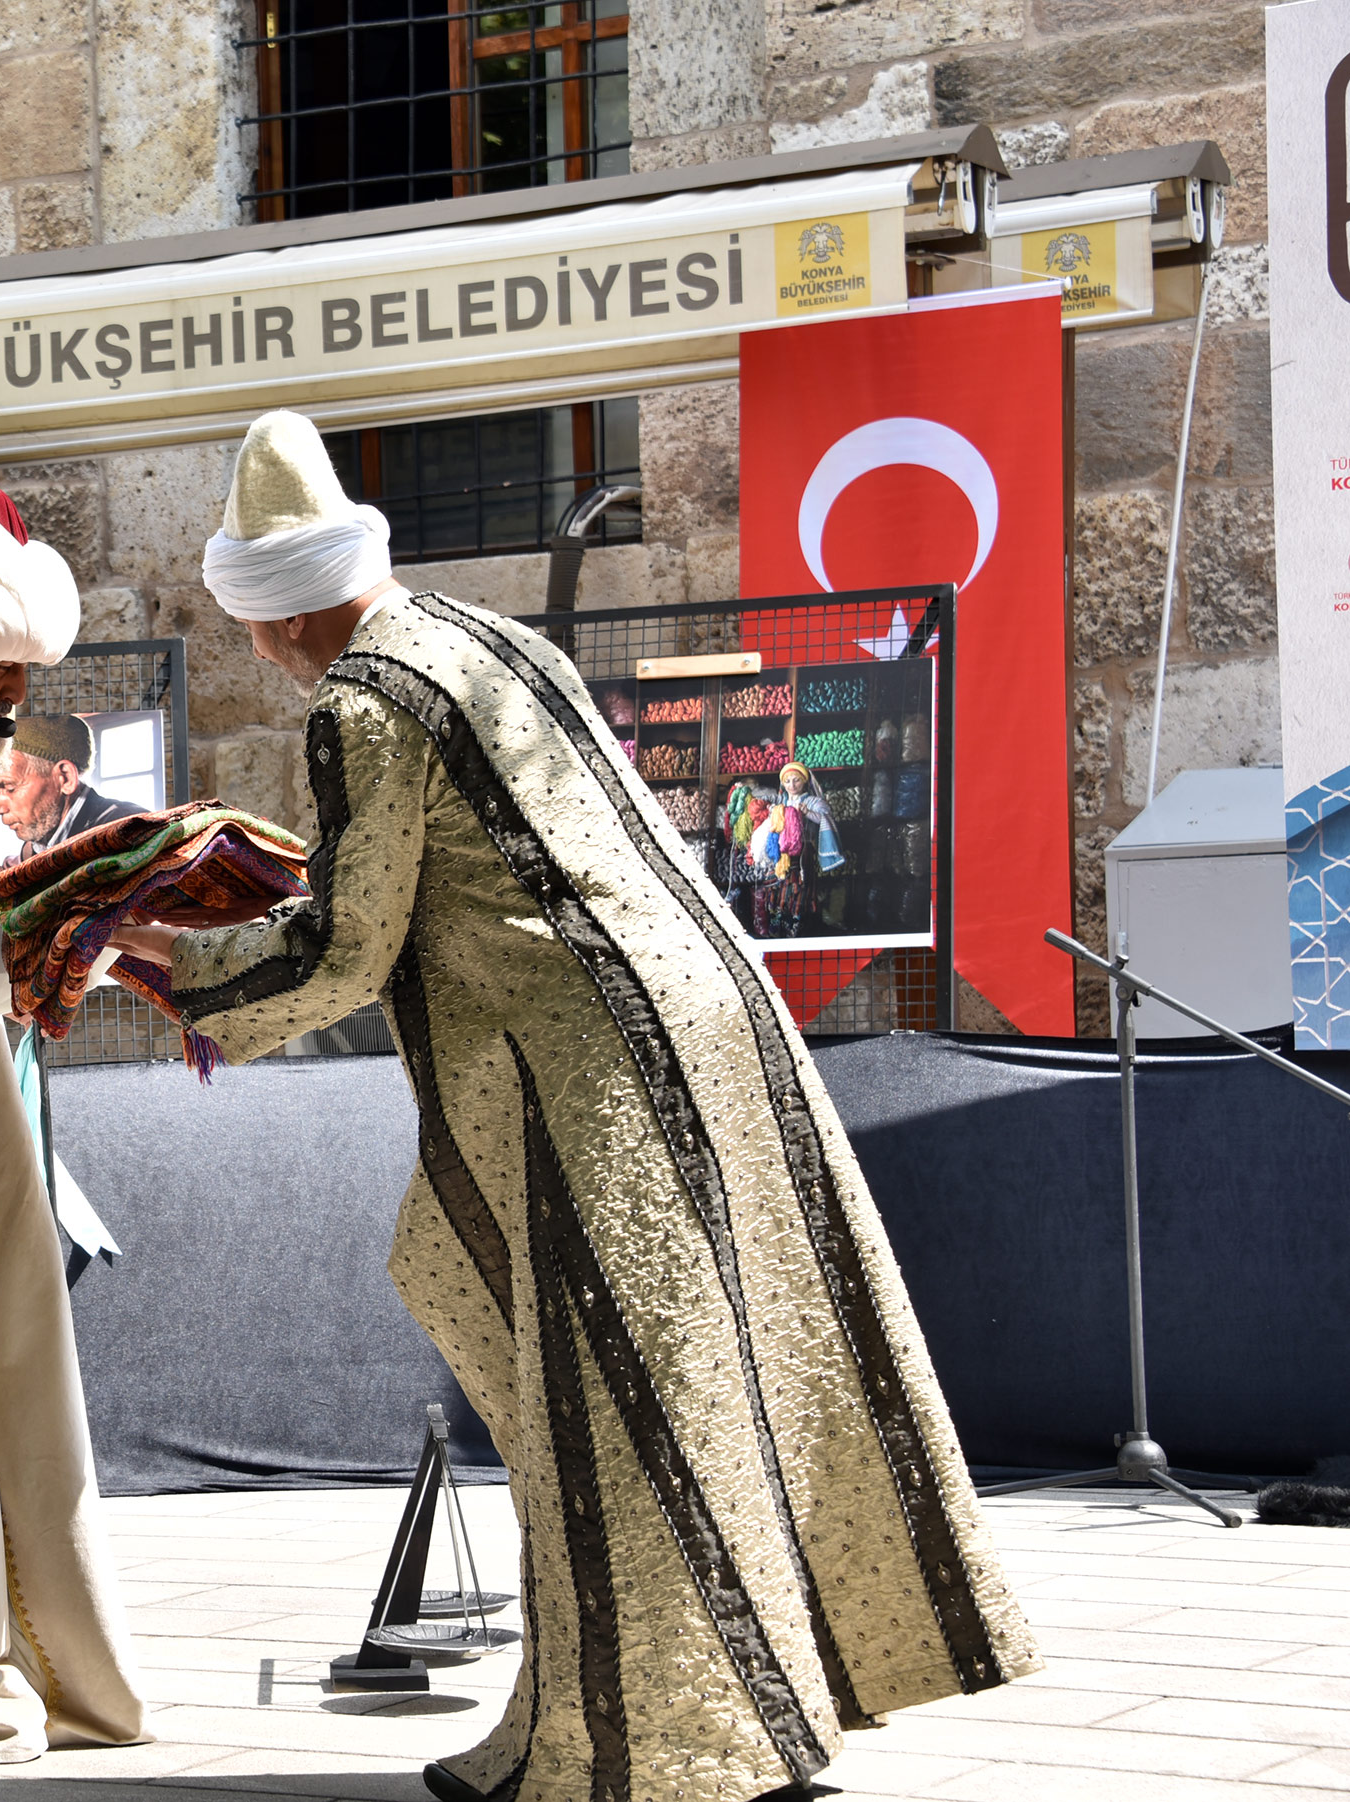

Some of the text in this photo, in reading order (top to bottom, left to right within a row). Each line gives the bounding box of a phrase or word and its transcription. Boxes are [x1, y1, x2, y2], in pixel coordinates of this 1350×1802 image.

[801, 265, 844, 280] KONYA
[322, 233, 743, 354] BELEDİYESİ
[780, 274, 866, 300] BÜYÜKŞEHİR
[1063, 282, 1111, 302] KŞEHİR
[797, 292, 849, 308] BELEDİYESİ
[1061, 300, 1096, 312] EDİYESİ
